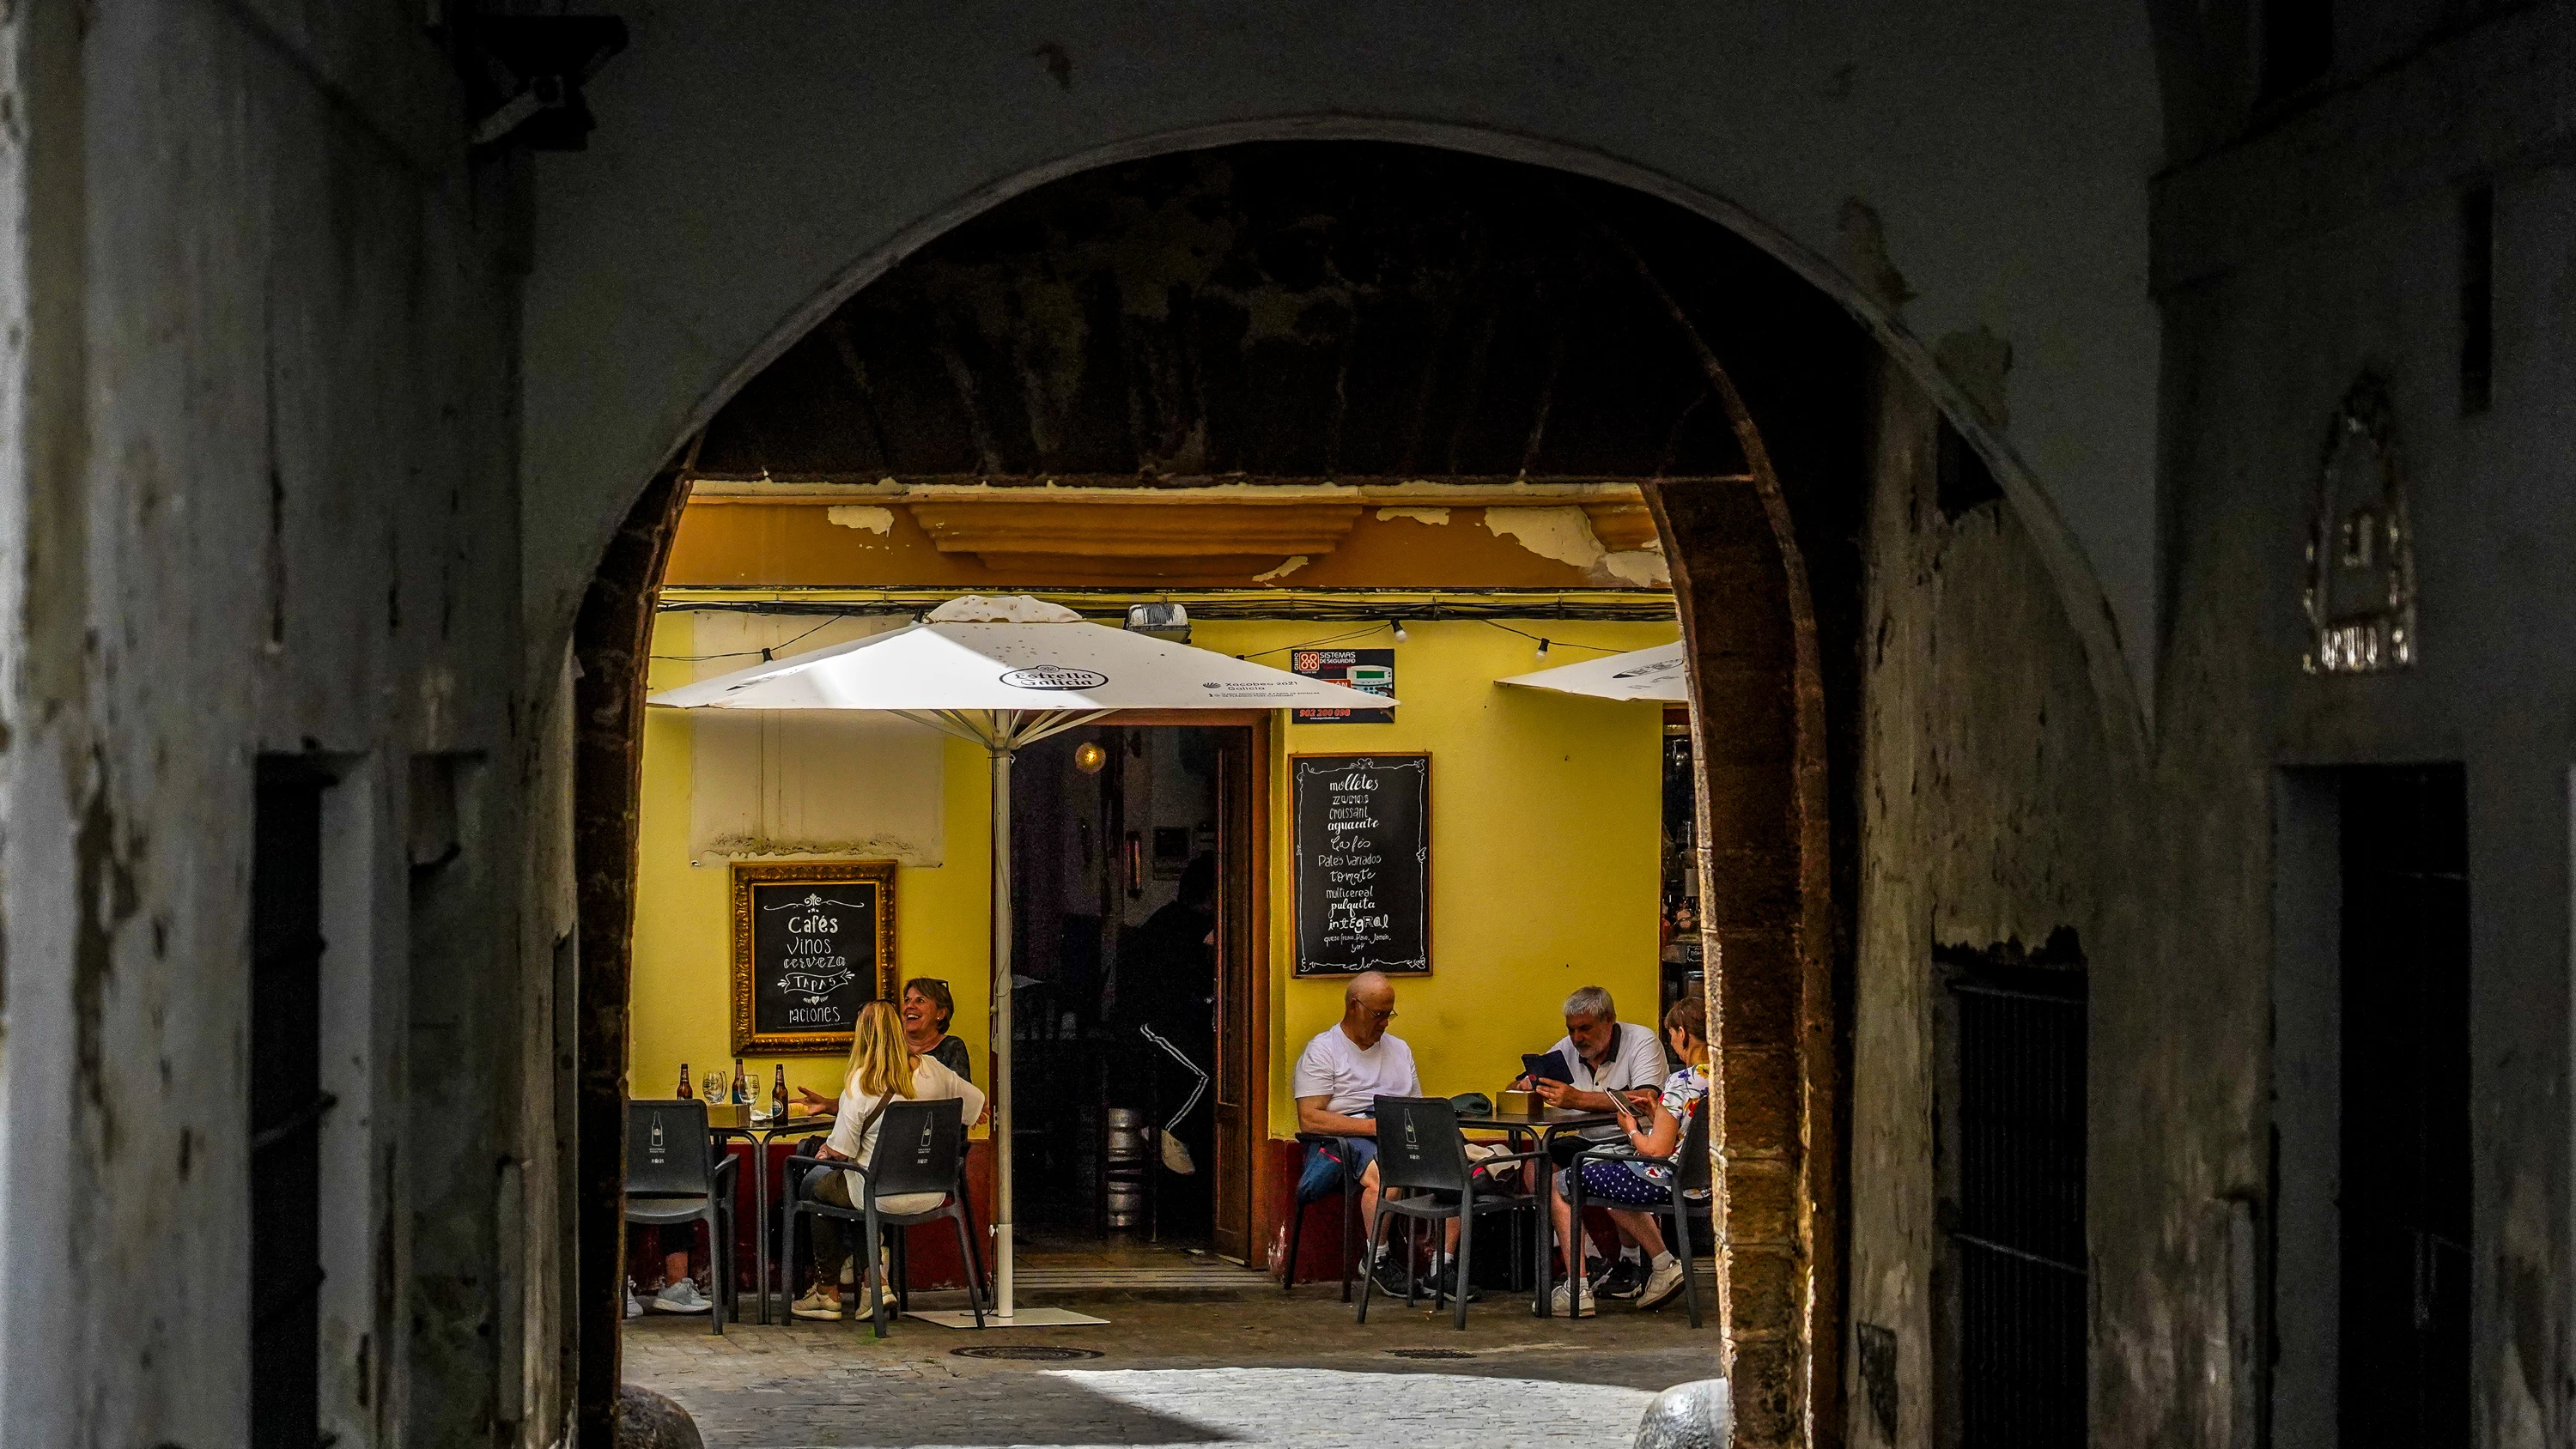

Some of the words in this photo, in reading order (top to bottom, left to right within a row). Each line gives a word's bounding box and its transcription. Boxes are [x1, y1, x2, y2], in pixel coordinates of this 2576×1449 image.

[1299, 709, 1316, 718] 902
[1329, 773, 1379, 791] molletes
[1329, 806, 1368, 820] croissant
[1327, 817, 1379, 835] aguacate
[1330, 868, 1376, 886] tomate
[1326, 885, 1374, 899] multicereal
[787, 915, 839, 934] Cafés
[787, 937, 831, 955] Vinos
[783, 955, 847, 969] cerveza
[793, 975, 837, 992] TAPAS
[789, 1006, 841, 1024] raciones
